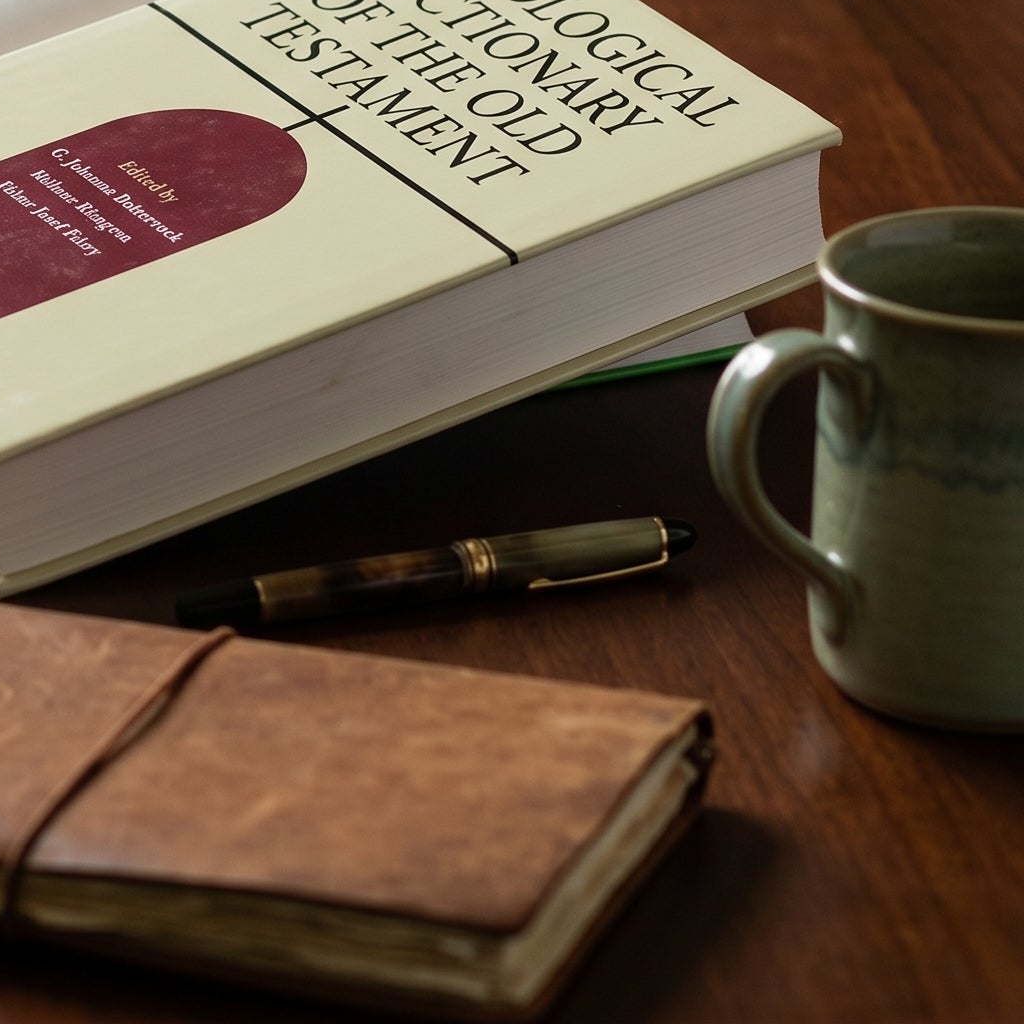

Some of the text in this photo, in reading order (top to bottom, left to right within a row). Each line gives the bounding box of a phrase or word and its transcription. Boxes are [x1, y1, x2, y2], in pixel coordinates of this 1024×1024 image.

[239, 1, 531, 186] TESTAMENT
[370, 21, 487, 93] THE
[466, 89, 583, 155] OLD
[117, 160, 179, 204] Edited by
